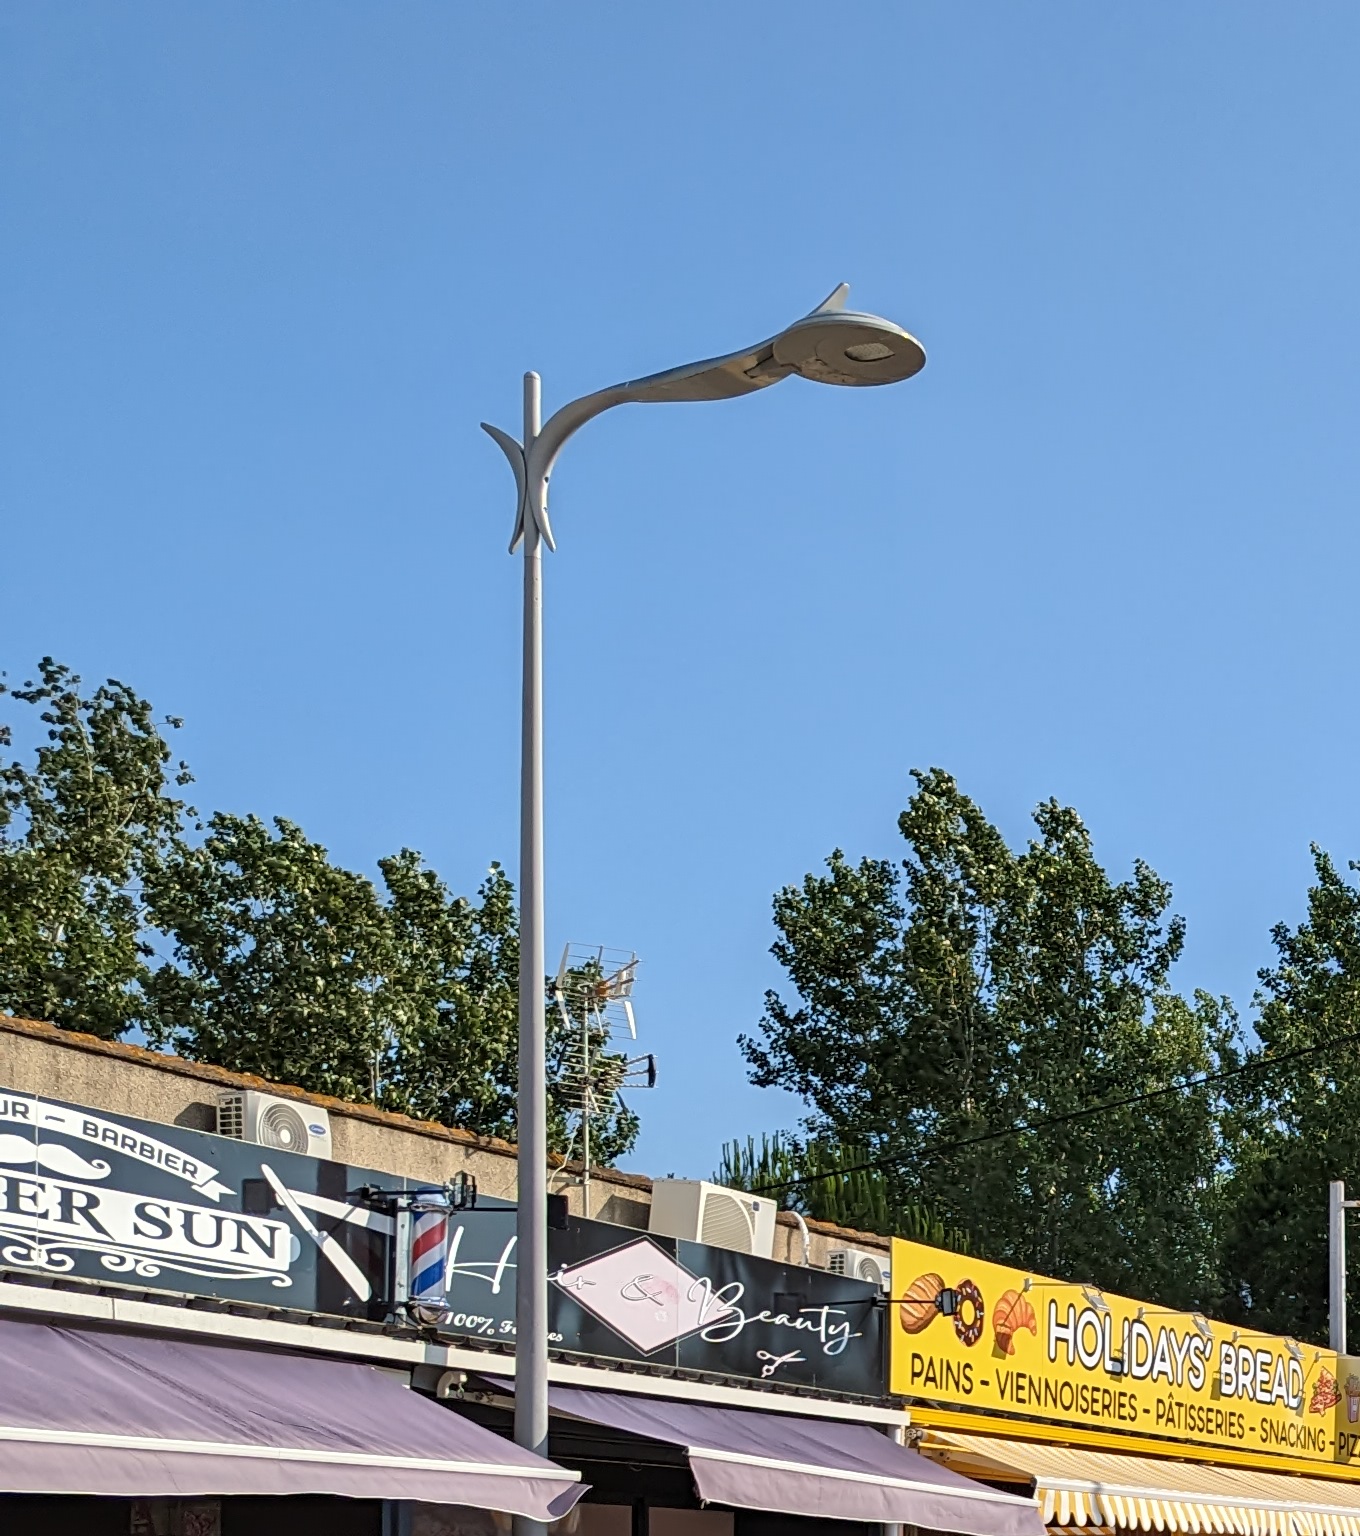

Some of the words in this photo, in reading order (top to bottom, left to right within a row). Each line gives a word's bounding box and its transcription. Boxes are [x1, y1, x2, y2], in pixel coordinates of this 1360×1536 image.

[82, 1118, 200, 1180] BARBIER
[0, 1175, 117, 1242] ER
[133, 1201, 289, 1260] SUN
[620, 1274, 665, 1307] &
[687, 1276, 864, 1356] Beauty
[1048, 1299, 1213, 1391] HOLIDAYS'
[1219, 1340, 1305, 1411] BREAD
[911, 1352, 975, 1395] PAINS
[995, 1367, 1139, 1423] VIENNOISERIES
[1155, 1391, 1246, 1440] PÂTISSERIES
[1259, 1417, 1327, 1454] SNACKING
